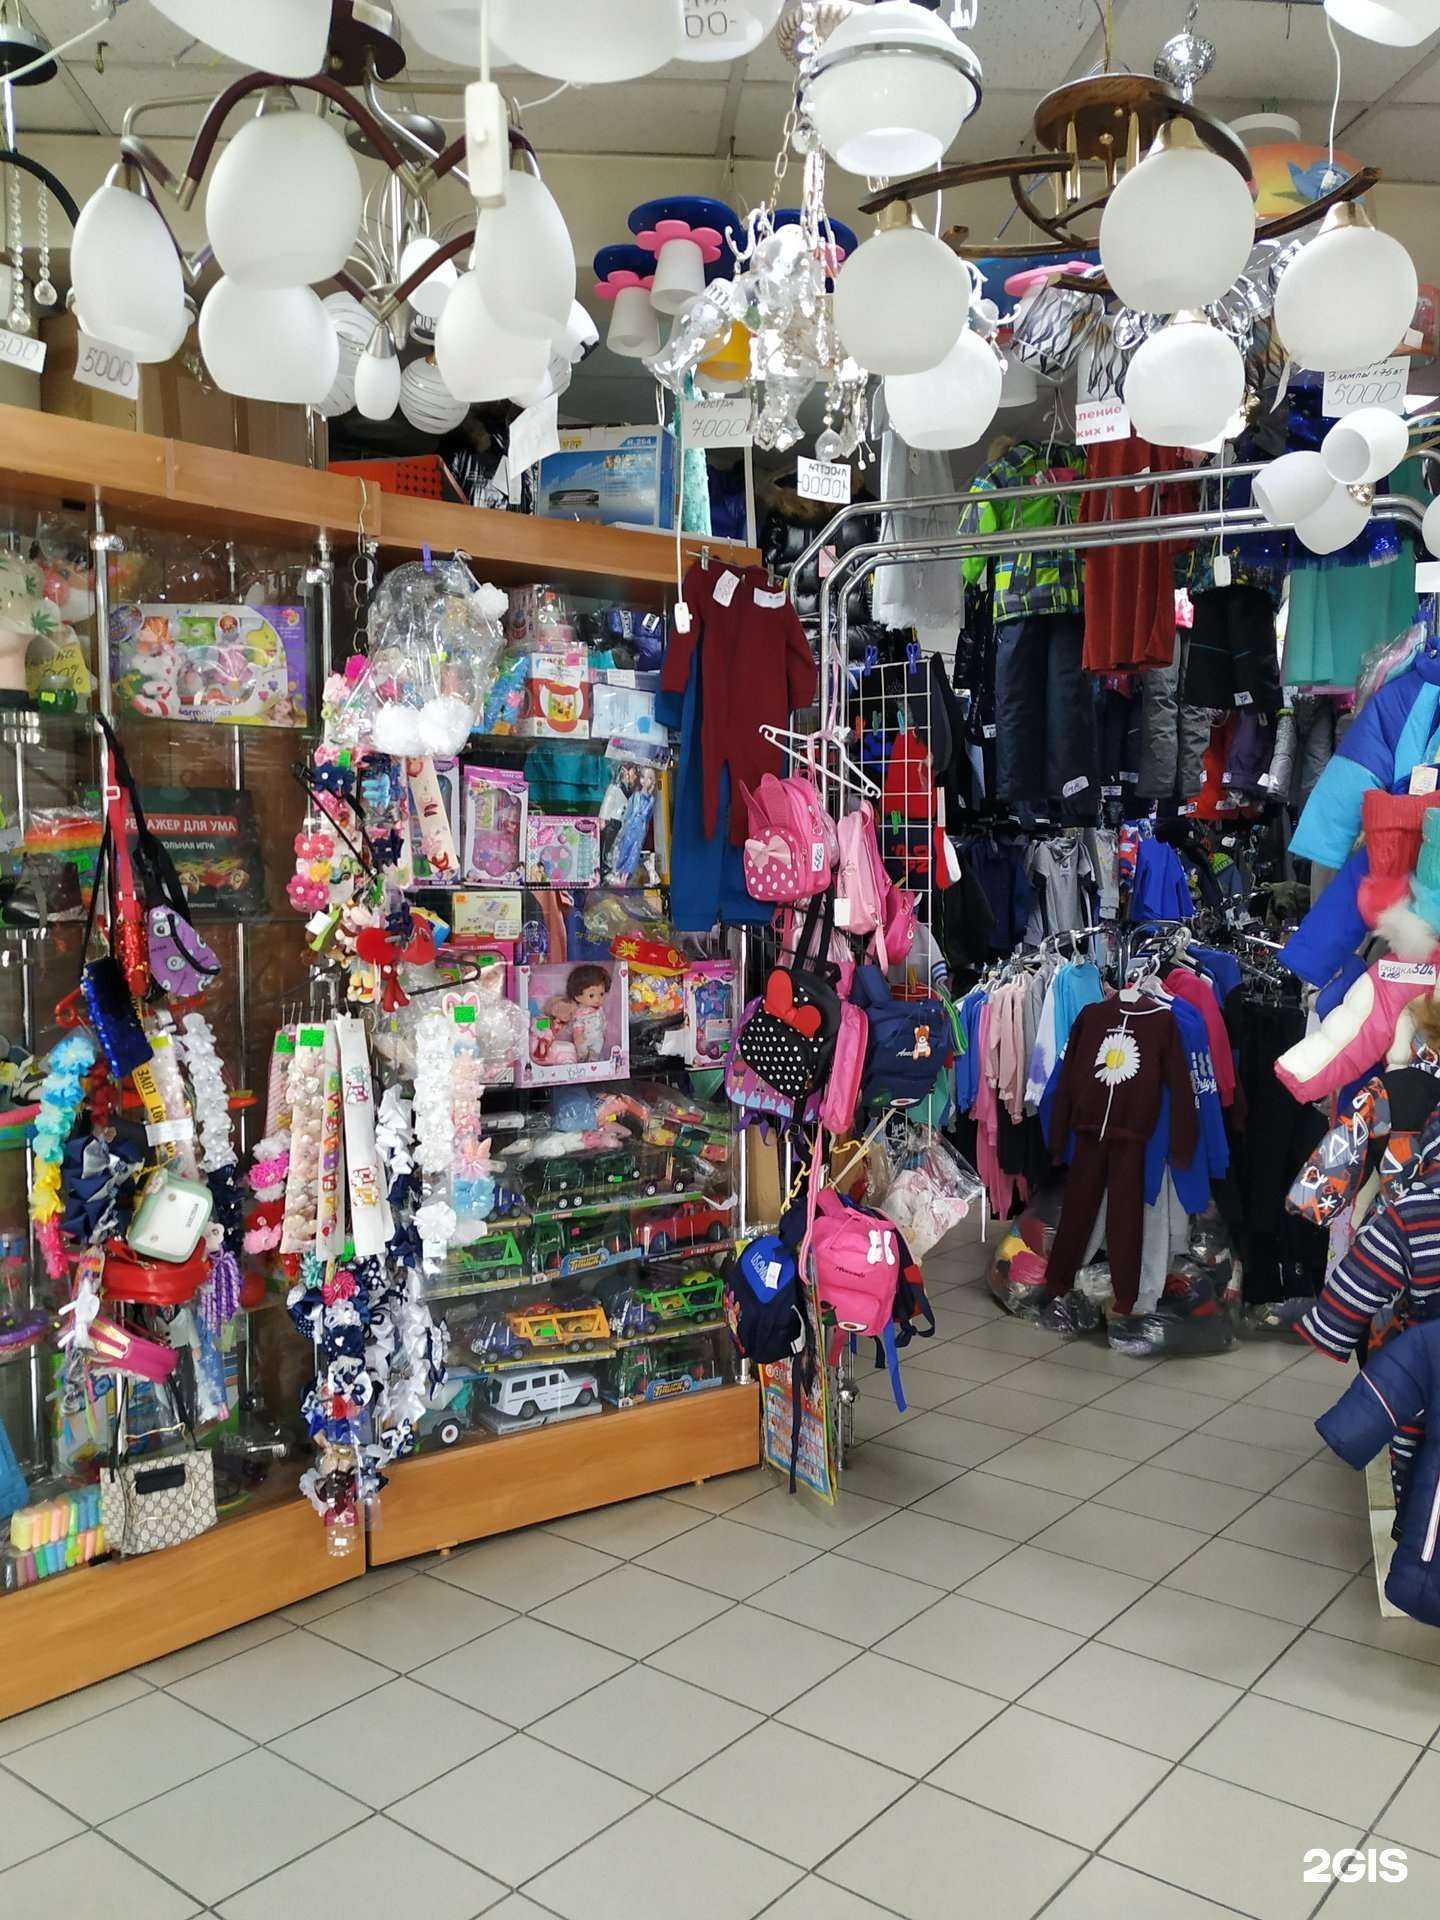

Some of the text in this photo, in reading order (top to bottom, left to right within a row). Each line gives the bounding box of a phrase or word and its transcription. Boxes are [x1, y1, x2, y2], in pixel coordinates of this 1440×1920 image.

[81, 346, 134, 386] 5000
[1327, 381, 1402, 405] 5000
[125, 818, 237, 833] РЕАЖЕР ДЛЯ УМА
